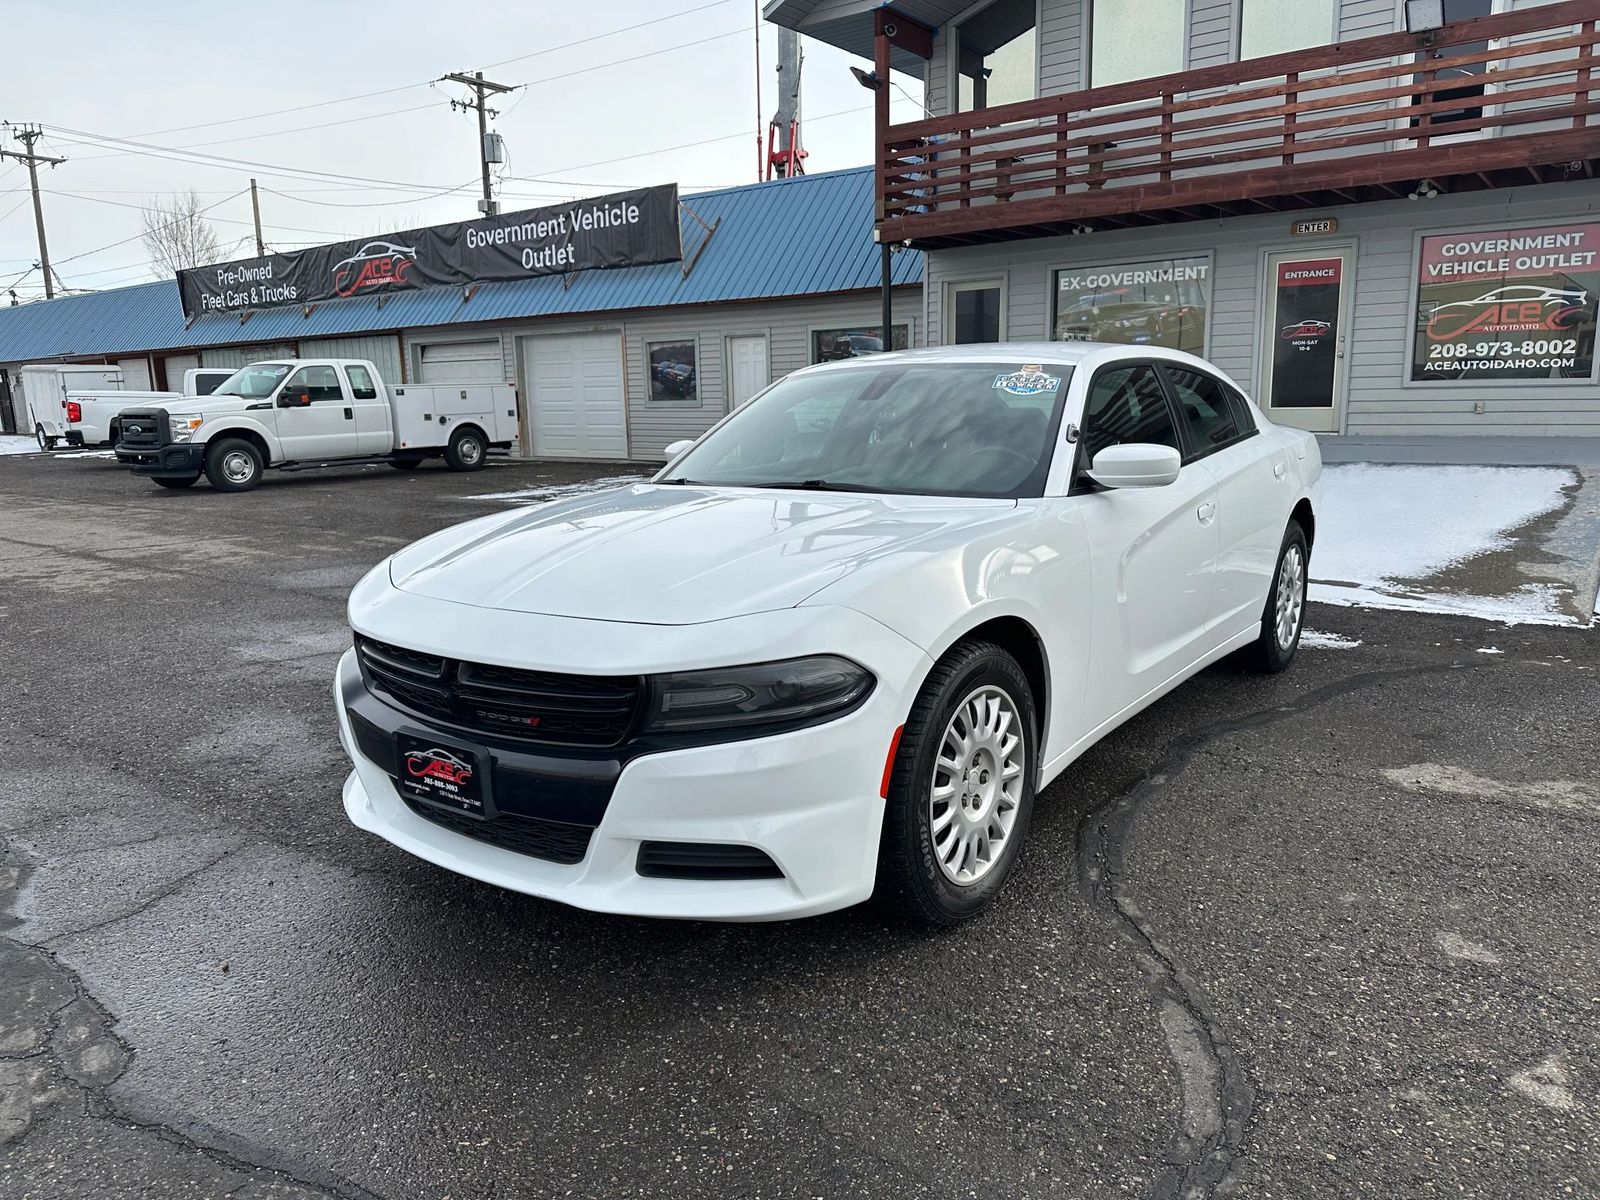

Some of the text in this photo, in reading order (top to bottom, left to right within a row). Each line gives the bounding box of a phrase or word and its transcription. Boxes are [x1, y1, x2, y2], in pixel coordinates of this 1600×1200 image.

[467, 202, 639, 249] Government Vehicle
[1298, 222, 1329, 233] ENTER
[521, 243, 575, 269] Outlet
[1441, 232, 1585, 257] GOVERNMENT
[217, 261, 272, 286] Pre-Owned
[1285, 269, 1335, 279] ENTRANCE
[1428, 251, 1597, 276] VEHICLE OUTLET
[1060, 265, 1208, 291] EX-GOVERNMENT
[201, 281, 297, 310] Fleet Cars & Trucks
[1483, 323, 1539, 332] AUTO IDAHO
[1429, 339, 1576, 358] 208-973-8002
[1424, 358, 1575, 371] ACEAUTOIDAHO.COM
